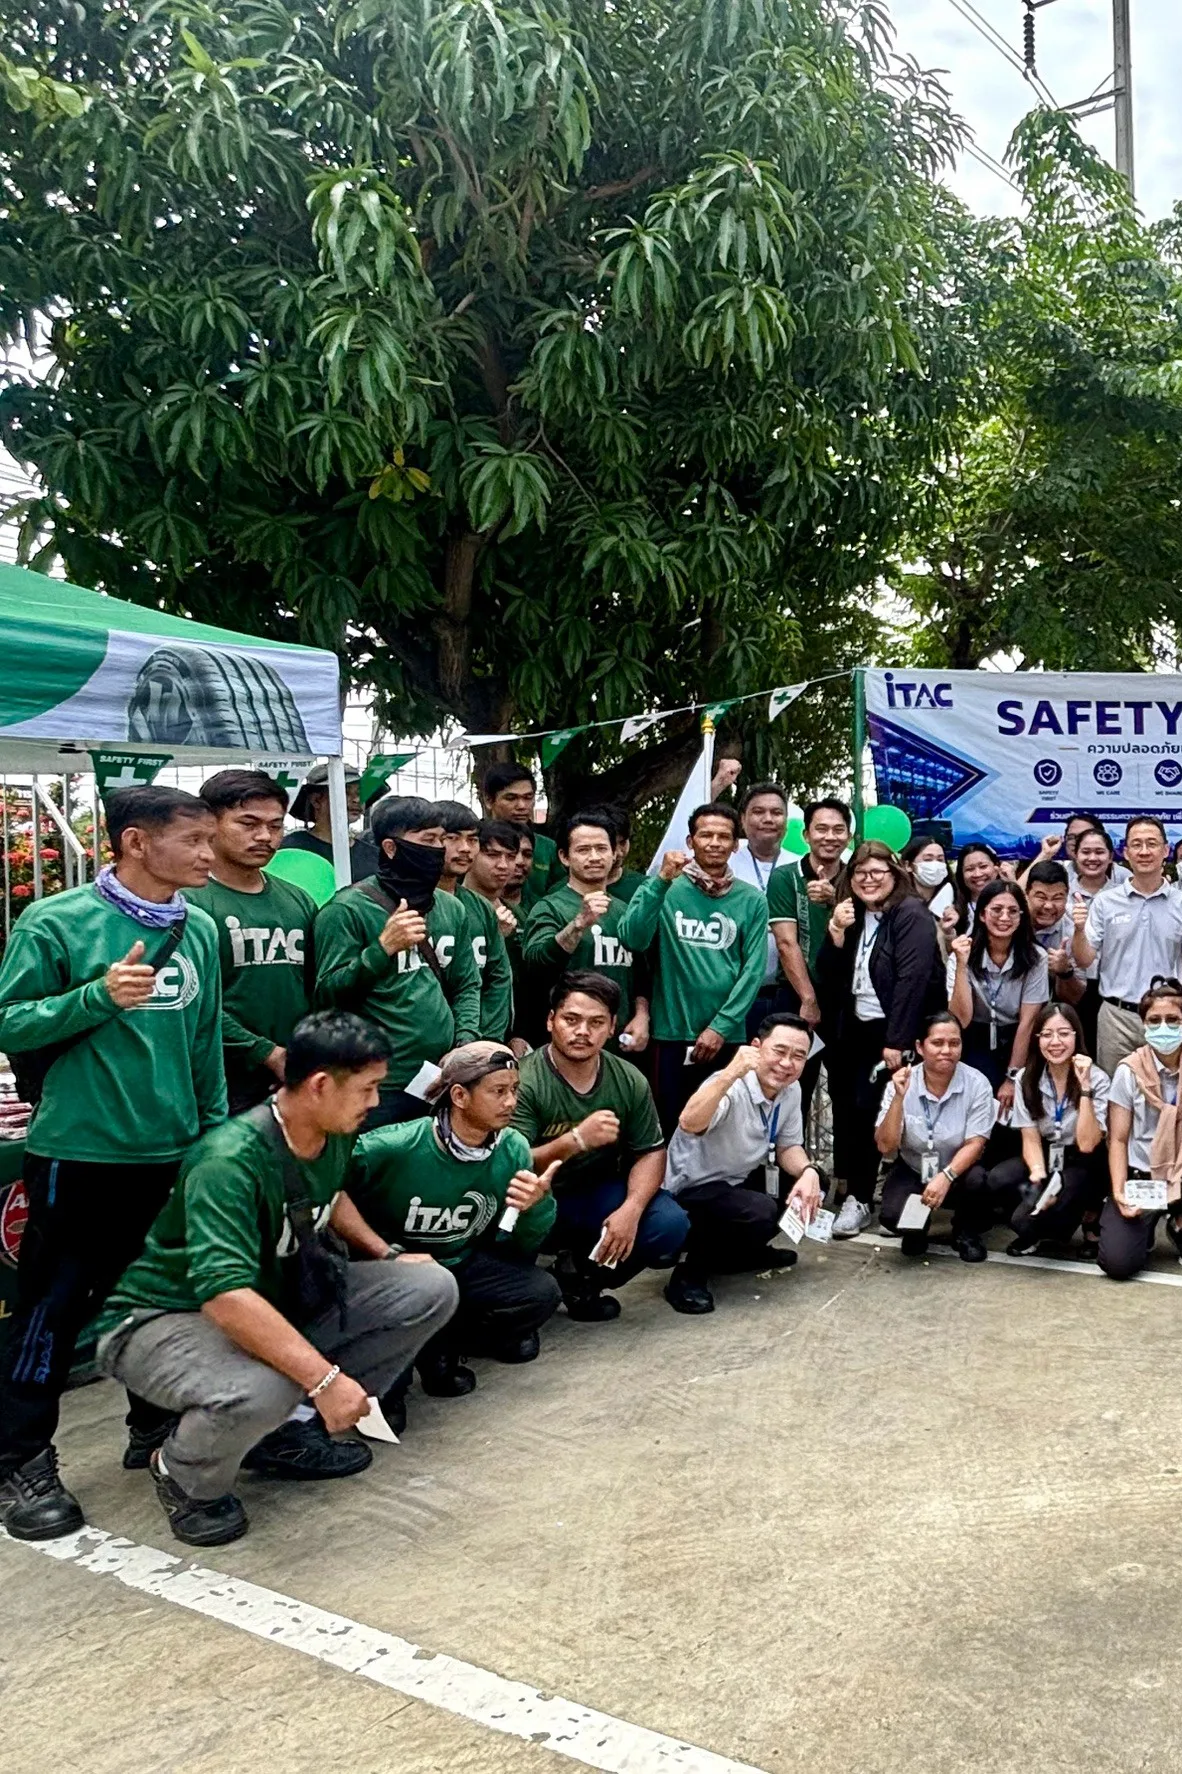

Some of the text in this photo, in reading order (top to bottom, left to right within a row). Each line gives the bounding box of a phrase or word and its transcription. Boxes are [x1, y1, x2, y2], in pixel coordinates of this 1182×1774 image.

[99, 754, 165, 767] SAFETY FIRST
[257, 760, 313, 769] SAFETY FIRST
[591, 924, 633, 967] iTA
